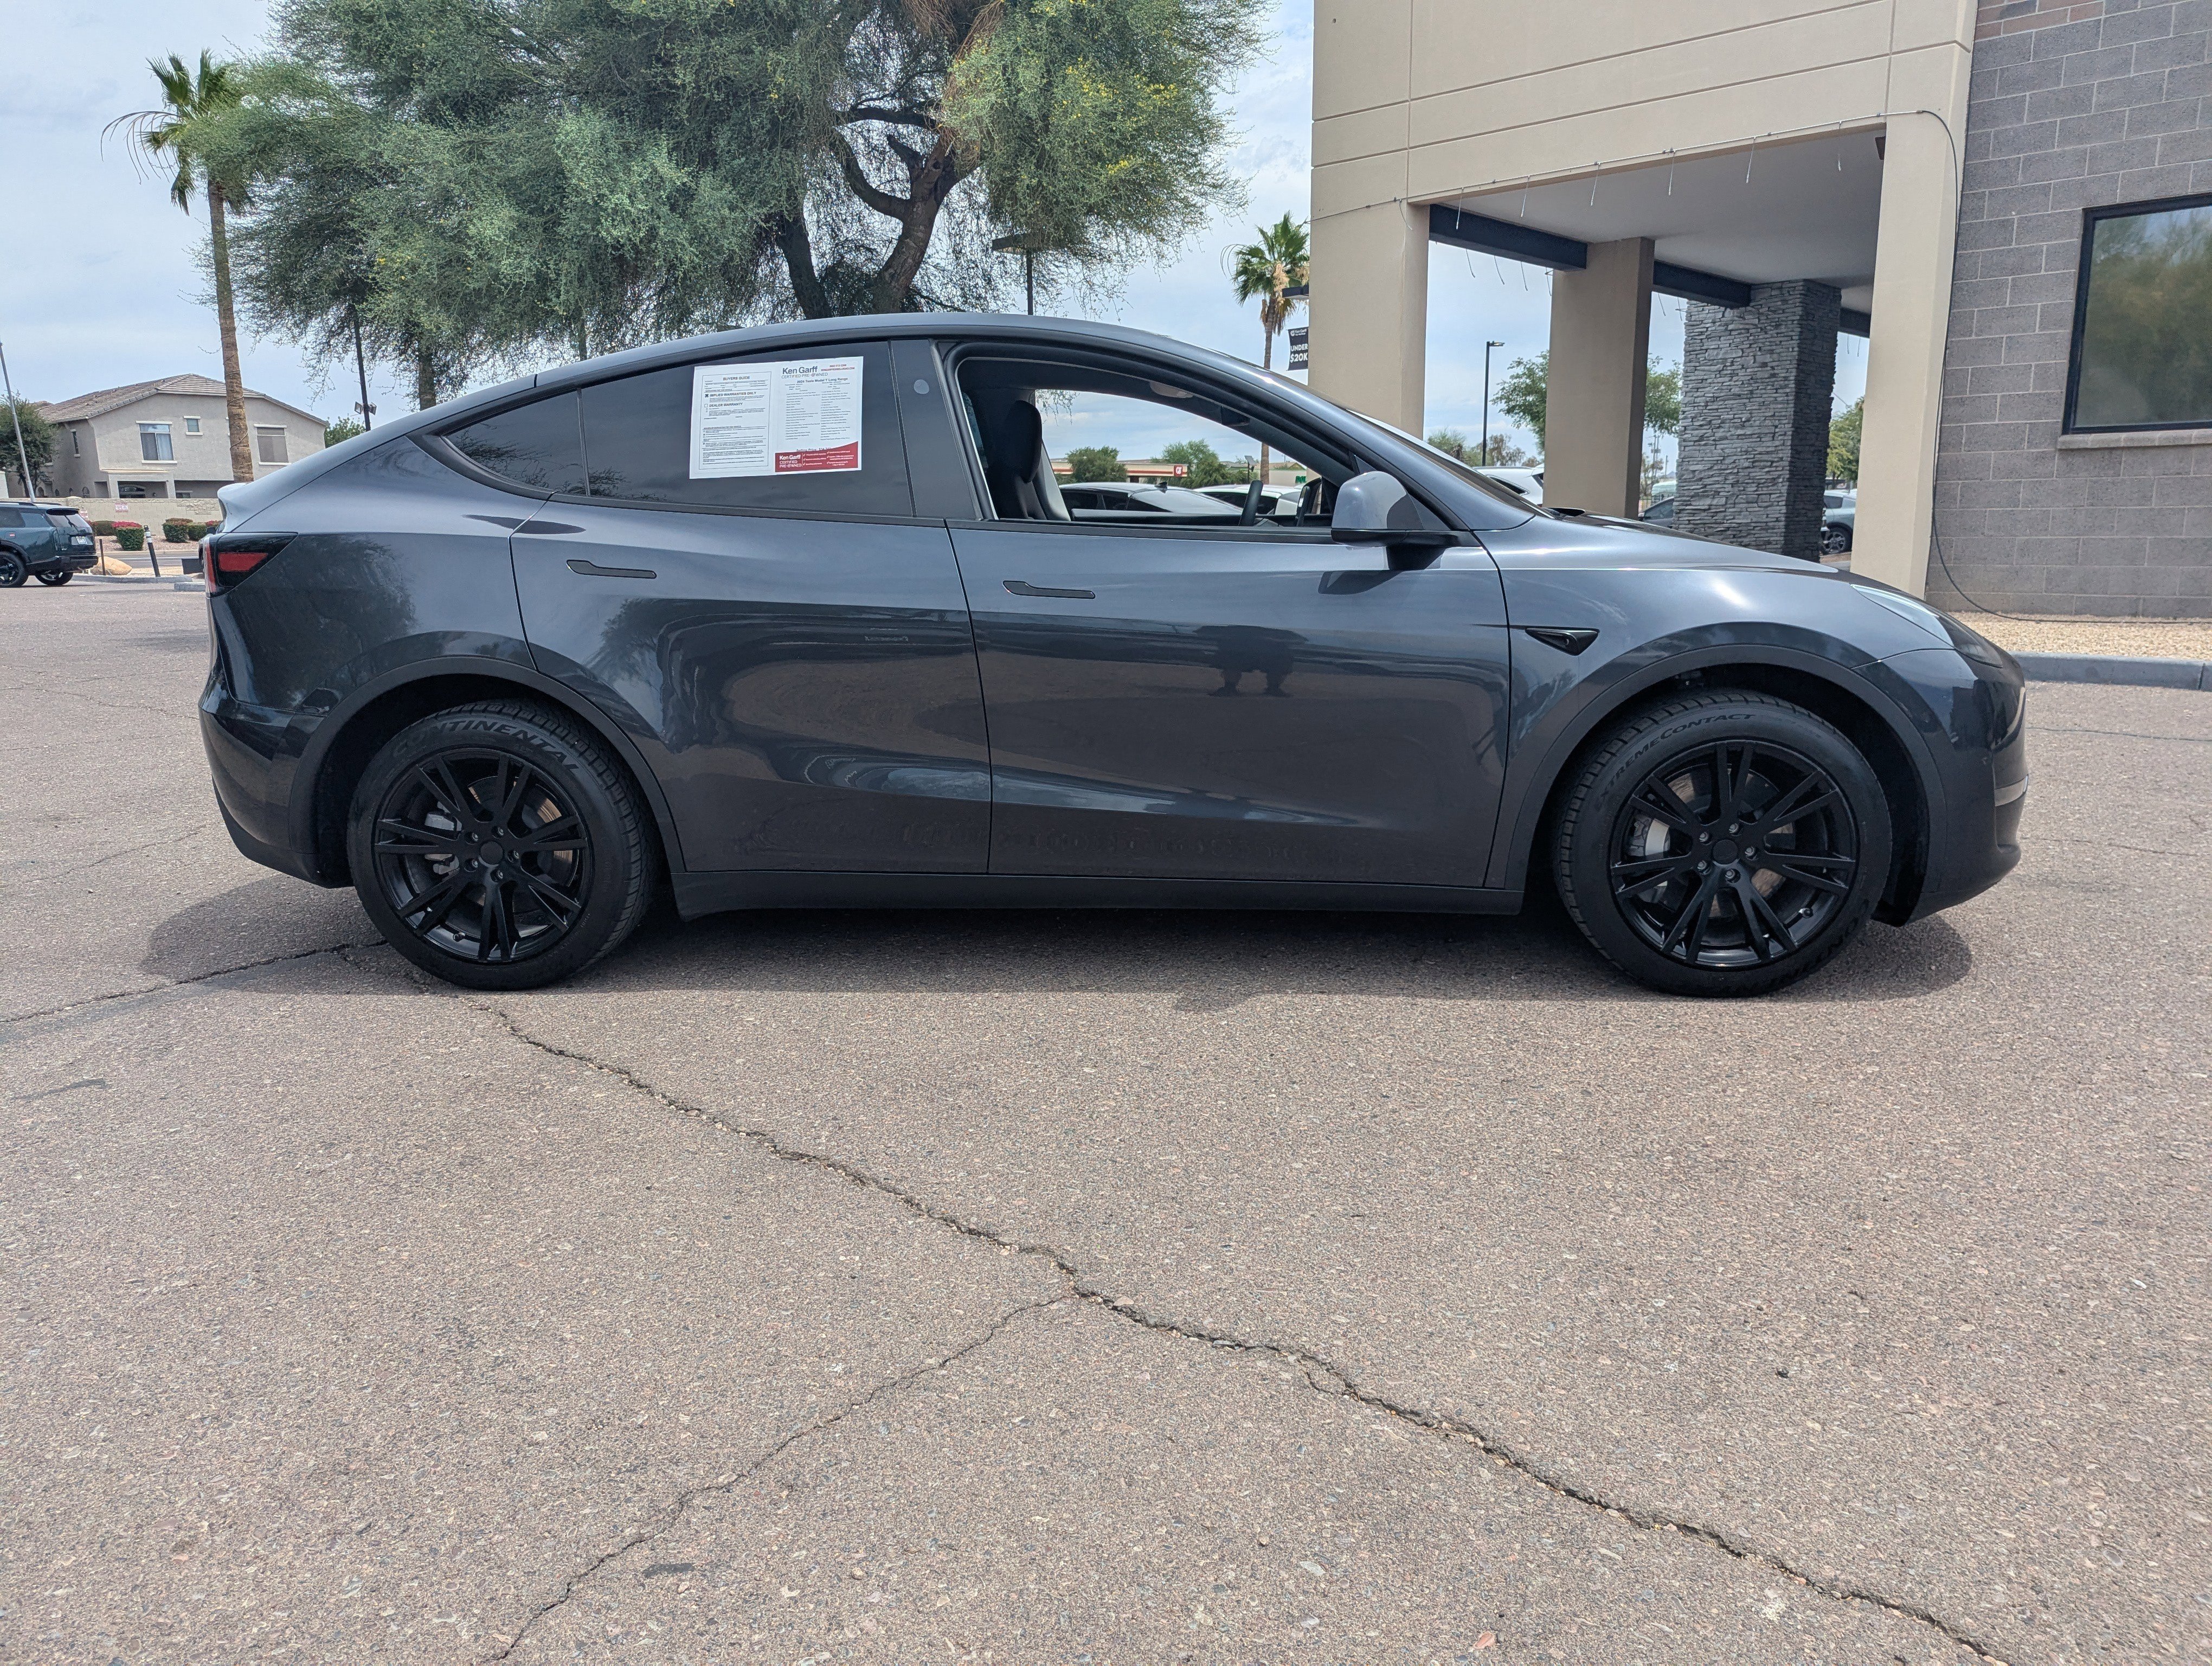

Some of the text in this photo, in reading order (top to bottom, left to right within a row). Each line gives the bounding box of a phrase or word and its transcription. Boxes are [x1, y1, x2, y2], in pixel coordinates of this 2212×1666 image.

[1290, 343, 1308, 351] UNDER
[1290, 353, 1308, 363] $20K
[799, 366, 818, 374] Garff
